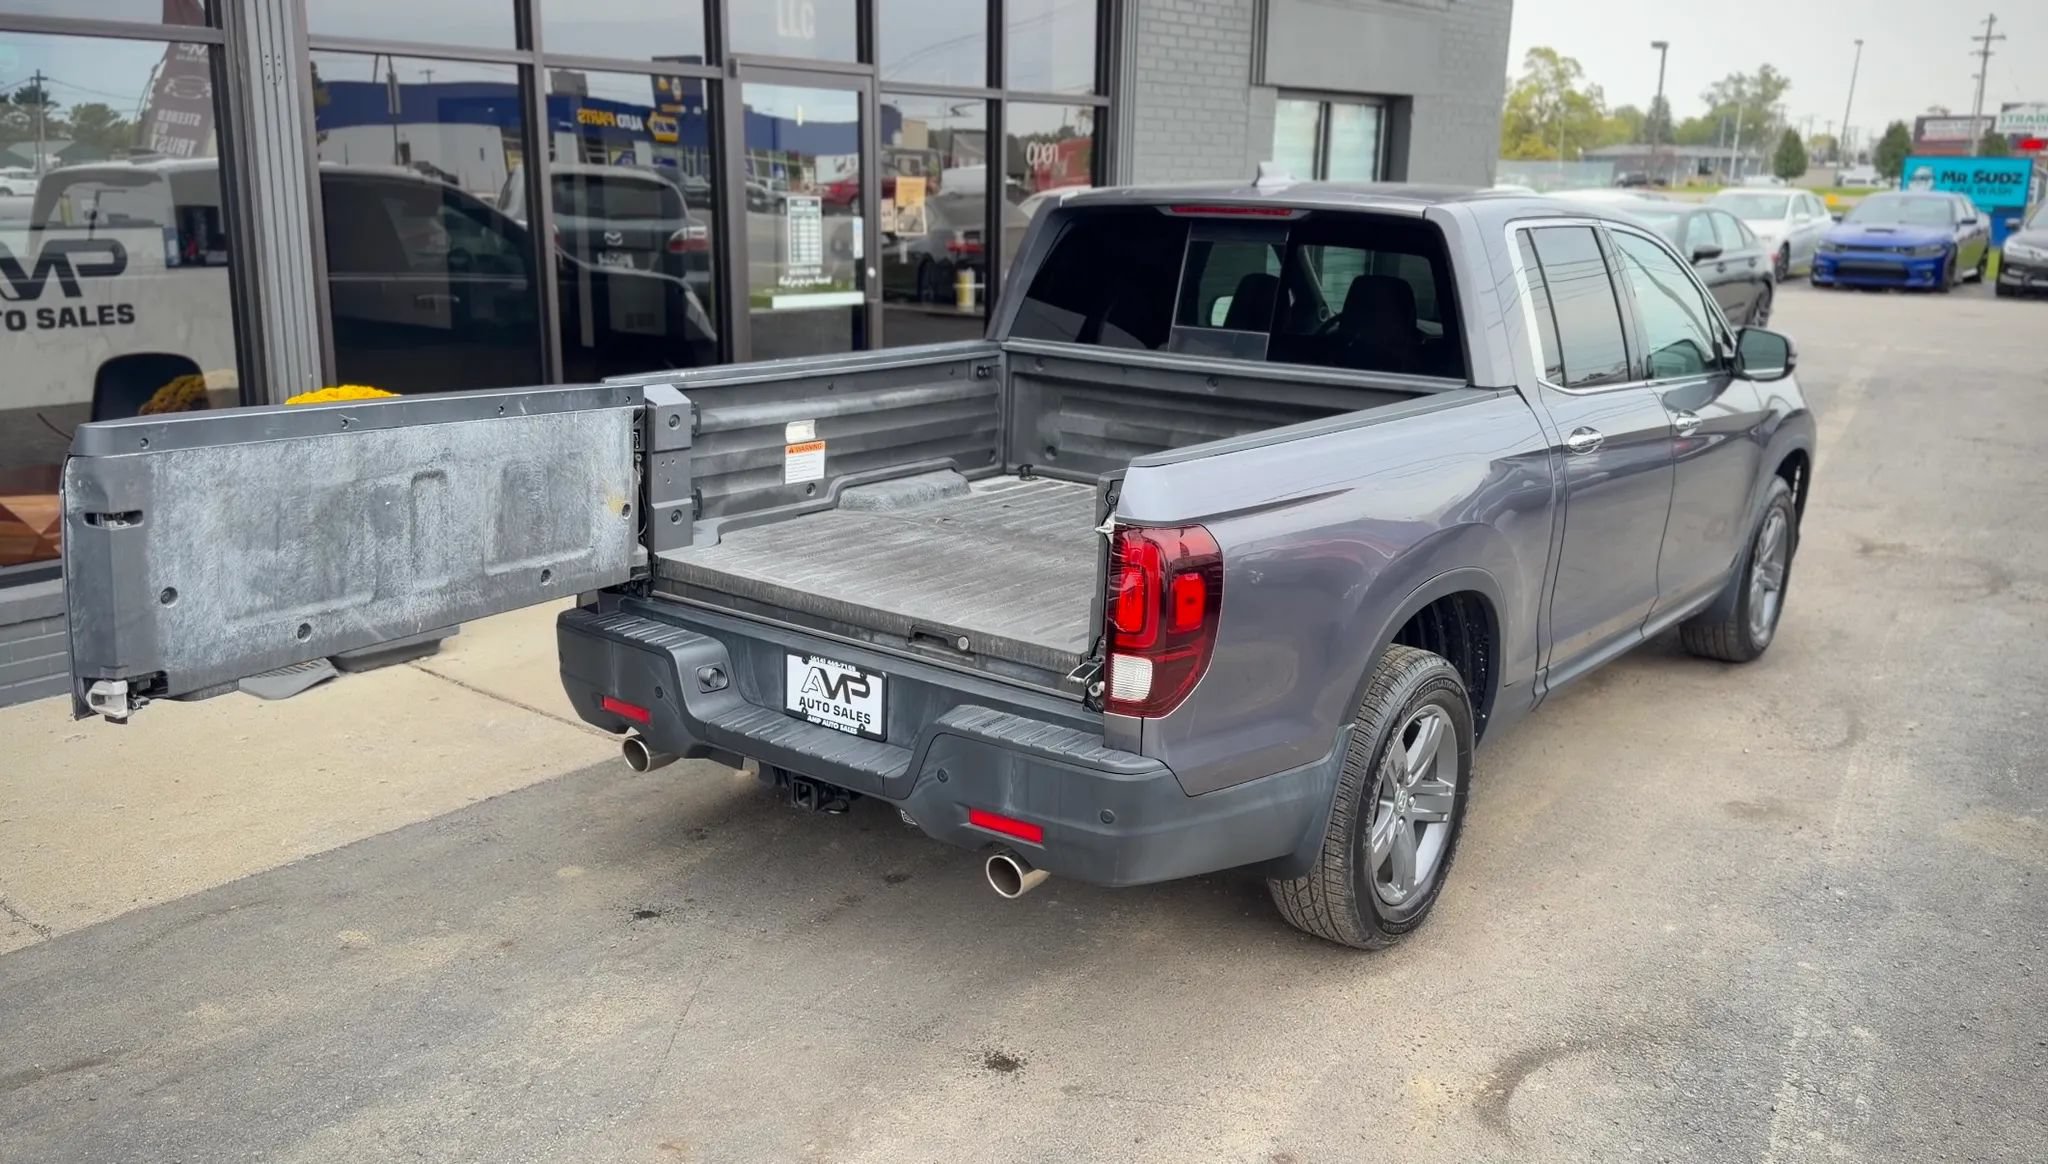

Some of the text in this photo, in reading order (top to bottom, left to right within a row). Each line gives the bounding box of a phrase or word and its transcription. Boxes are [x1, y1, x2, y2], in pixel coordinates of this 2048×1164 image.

[36, 303, 135, 330] SALES
[799, 696, 871, 725] AUTO SALES
[807, 714, 858, 735] AMP AUTO SALES
